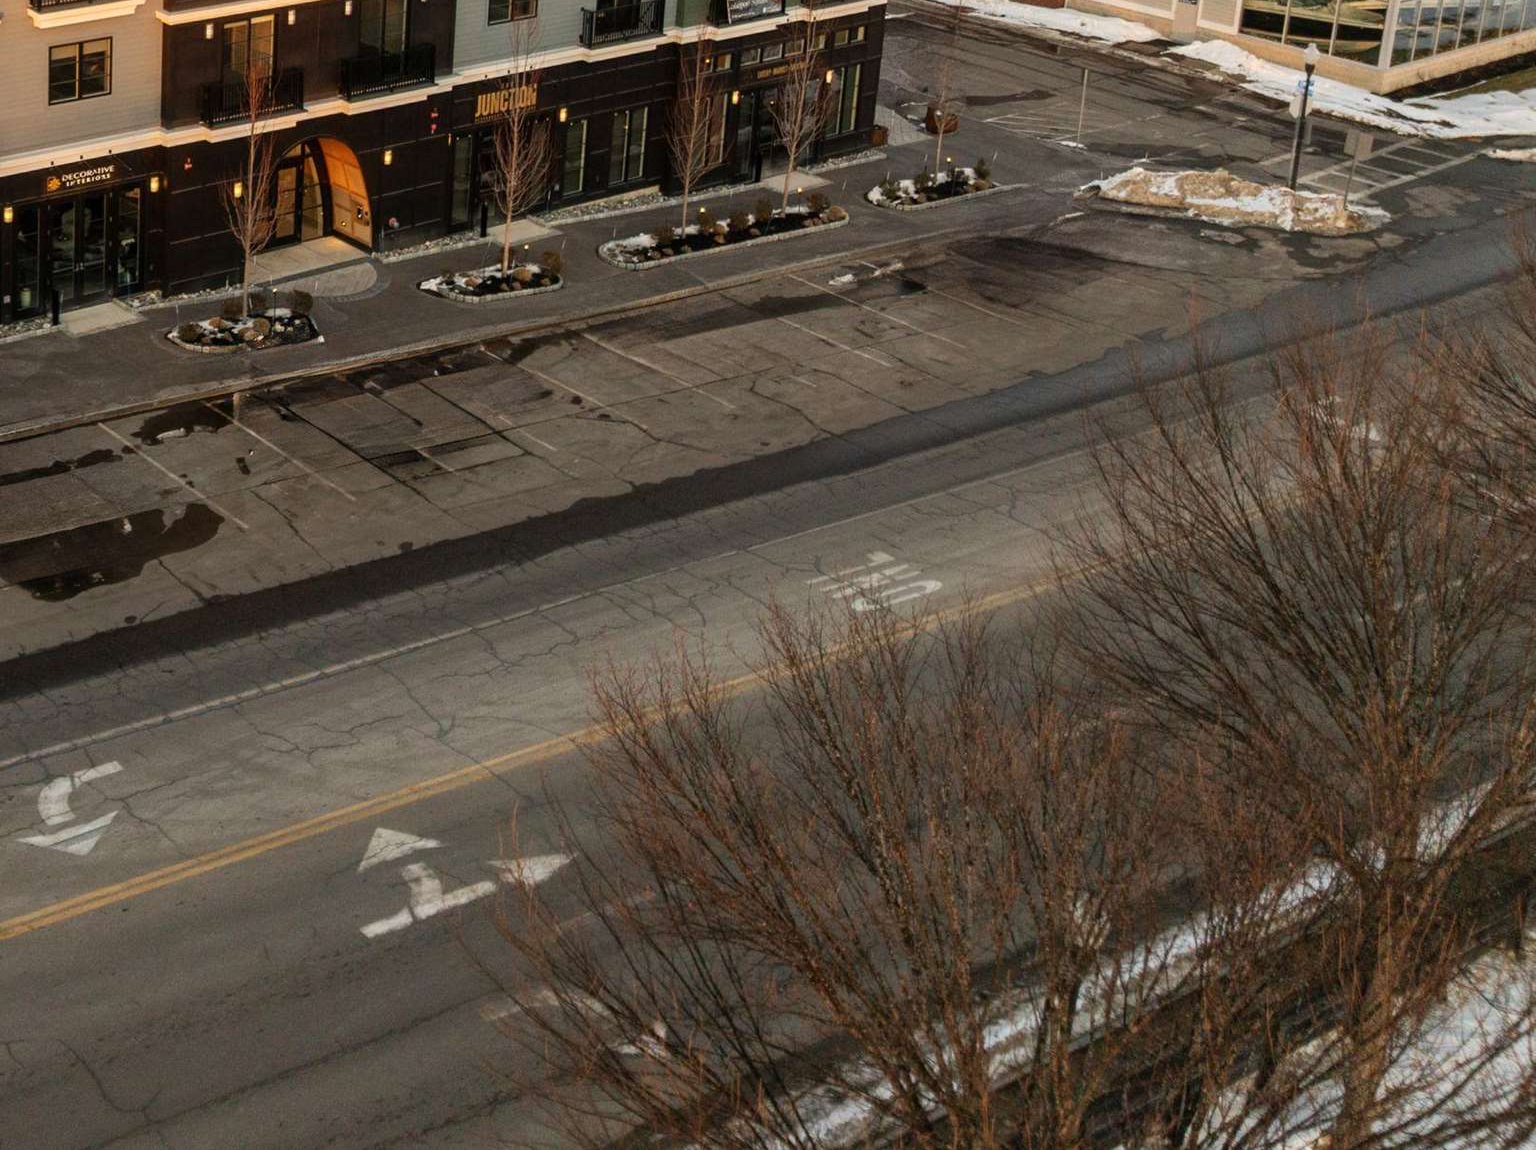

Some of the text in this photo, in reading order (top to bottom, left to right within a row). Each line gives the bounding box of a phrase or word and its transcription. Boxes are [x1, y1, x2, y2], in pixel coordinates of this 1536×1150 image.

[474, 82, 539, 118] JUNCTION
[62, 164, 115, 182] DECORATIVE
[66, 172, 112, 188] INTERIORS
